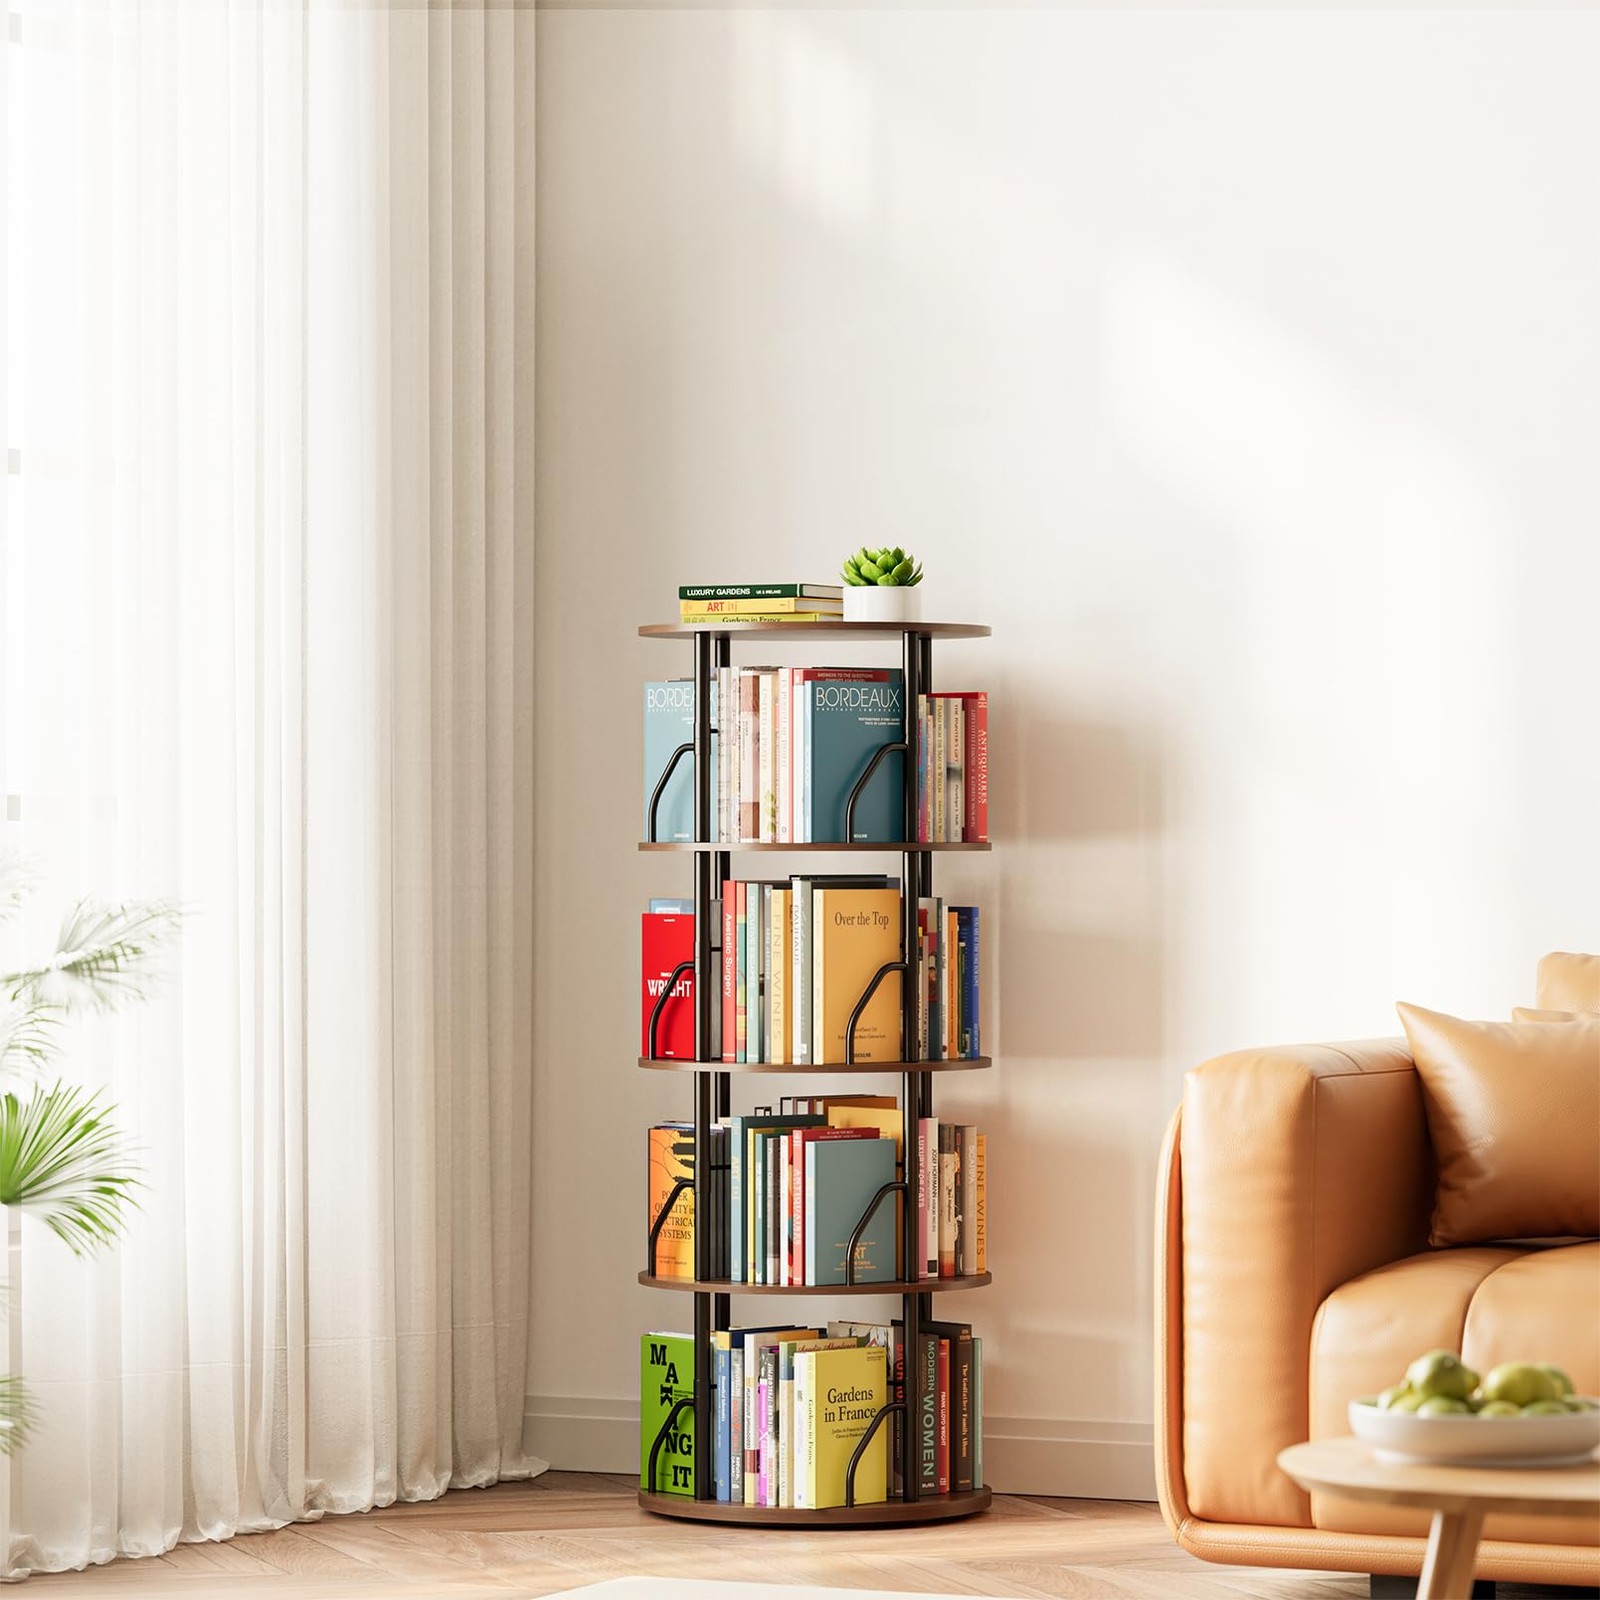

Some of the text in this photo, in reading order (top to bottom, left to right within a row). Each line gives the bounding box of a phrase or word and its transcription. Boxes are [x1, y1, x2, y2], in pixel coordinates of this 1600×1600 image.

[706, 602, 725, 612] ART
[816, 687, 900, 708] BORDEAUX
[834, 911, 889, 929] Over the Top
[725, 957, 733, 997] Surgery
[773, 914, 782, 1040] FINE WINES
[976, 1155, 984, 1255] FINE WINES
[853, 1247, 867, 1259] RT
[827, 1386, 874, 1404] Gardens
[824, 1405, 877, 1422] in France
[923, 1394, 934, 1476] WOMEN
[672, 1465, 692, 1488] IT
